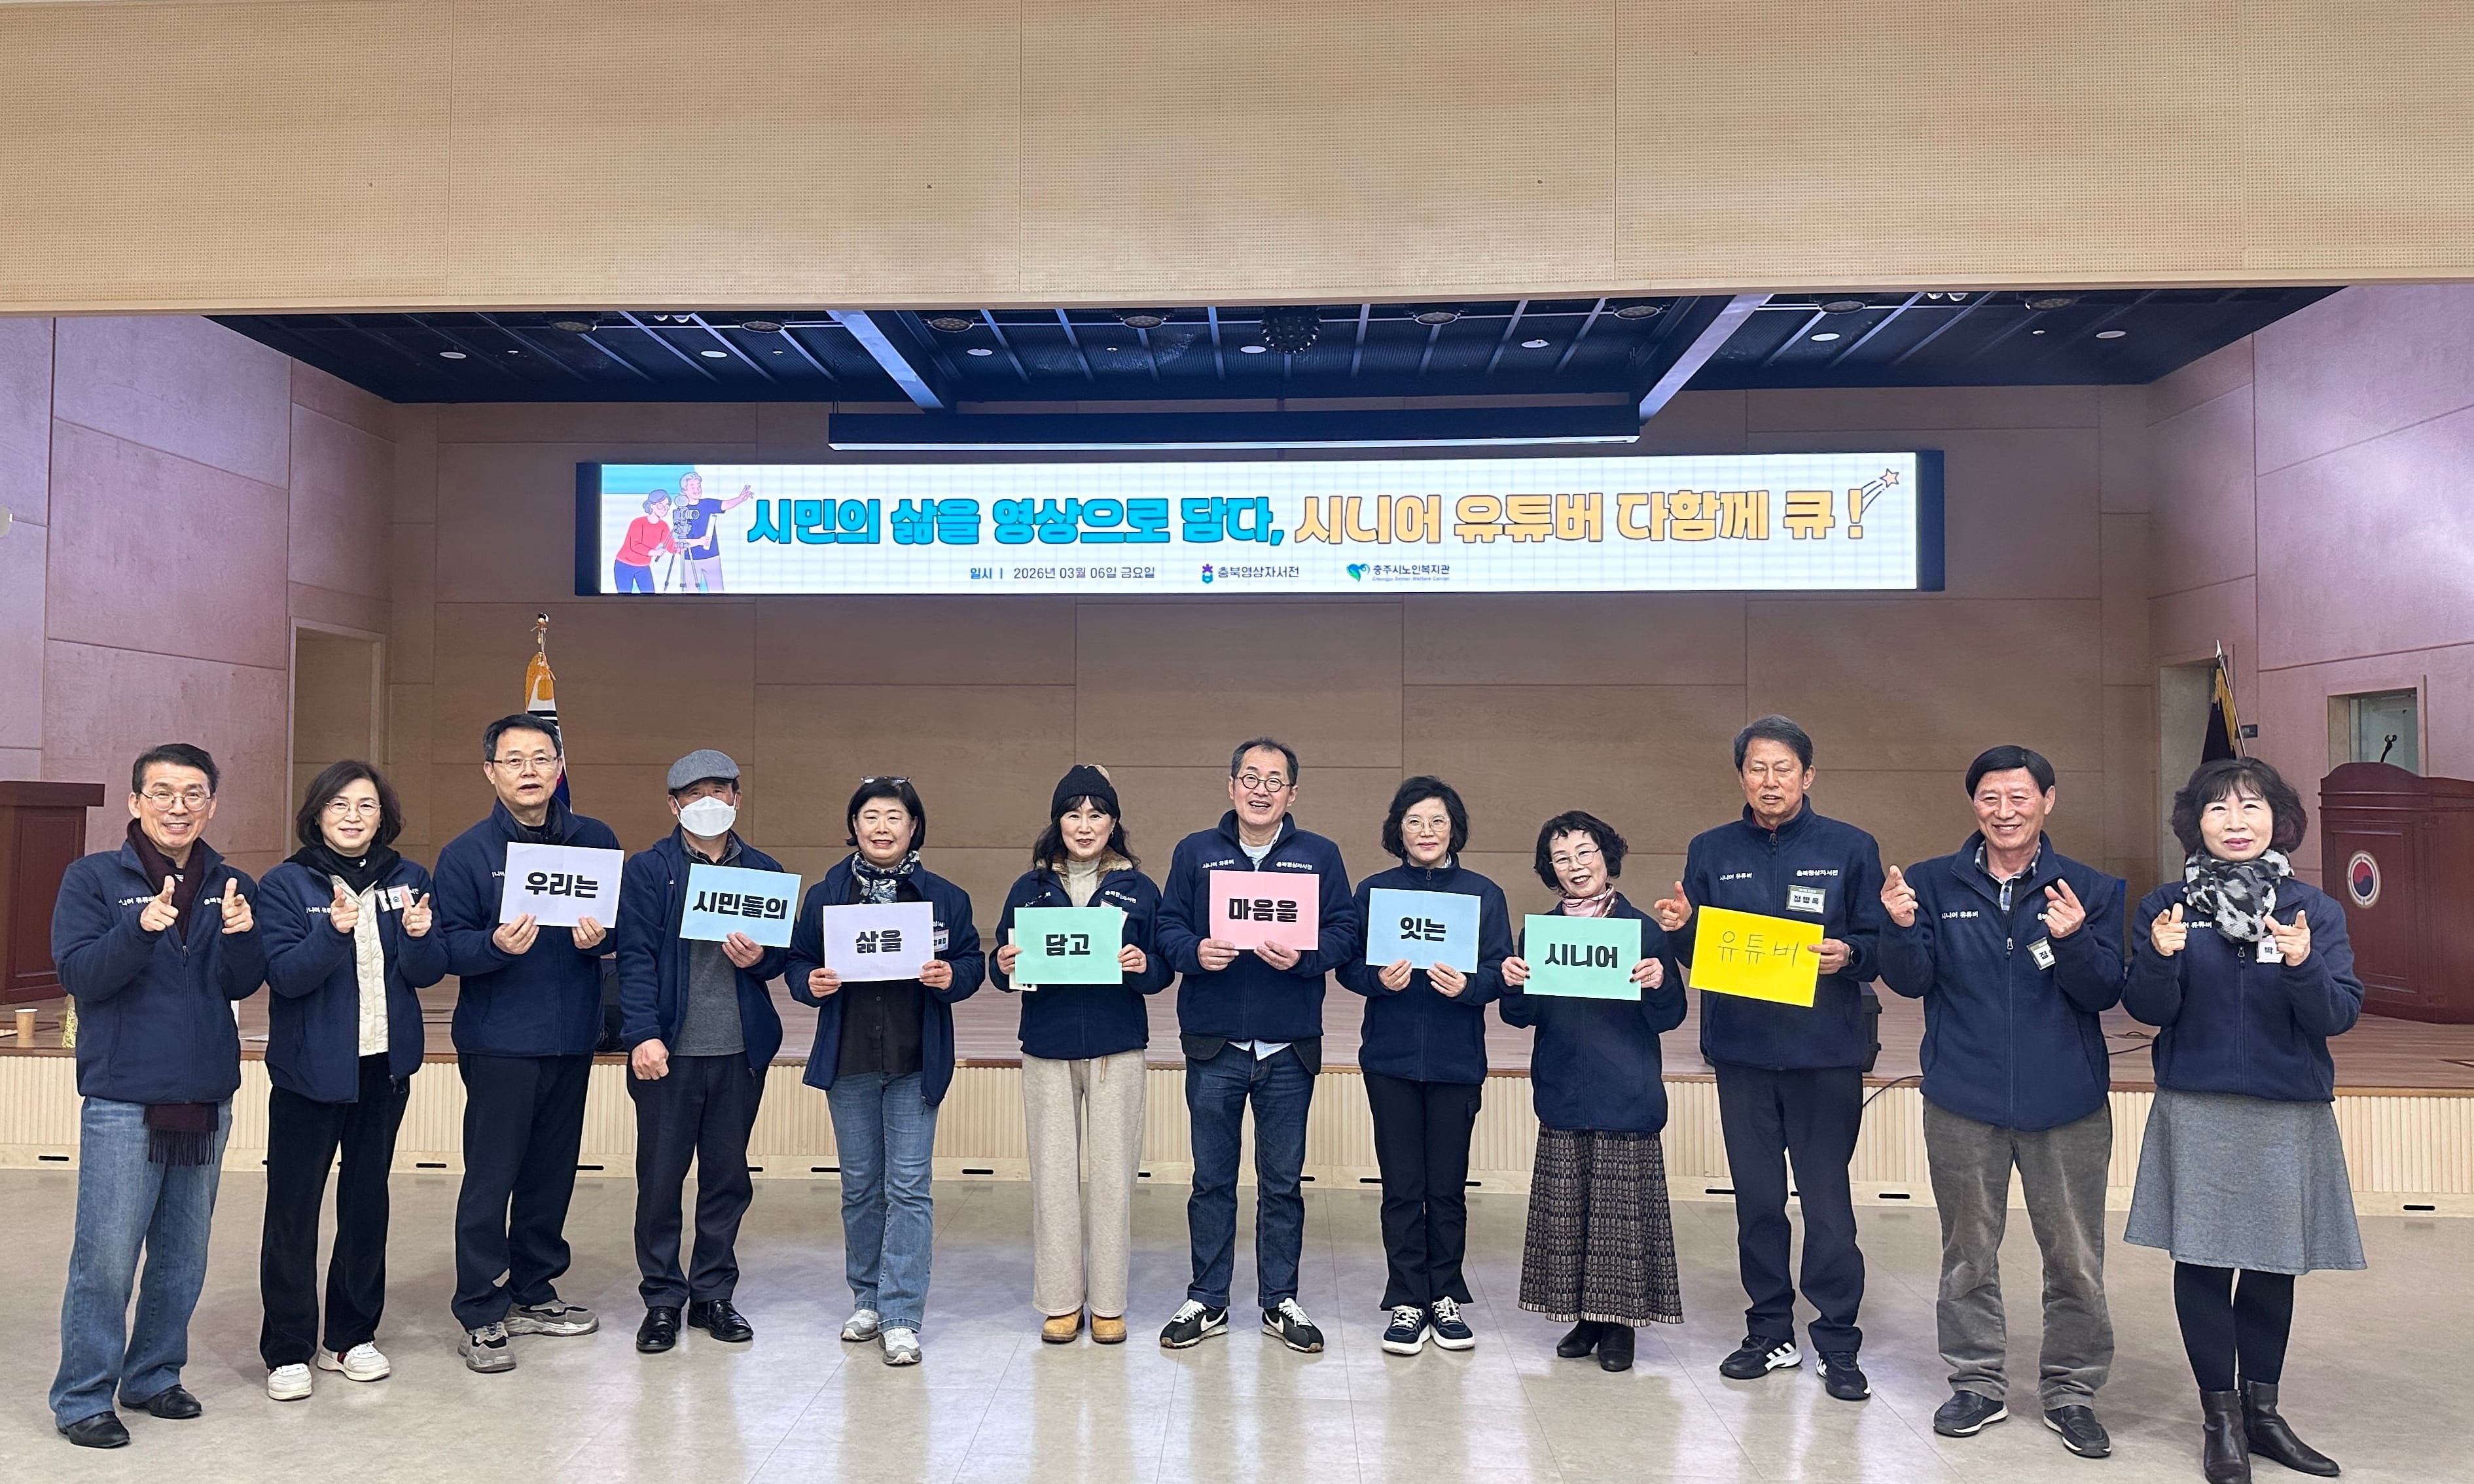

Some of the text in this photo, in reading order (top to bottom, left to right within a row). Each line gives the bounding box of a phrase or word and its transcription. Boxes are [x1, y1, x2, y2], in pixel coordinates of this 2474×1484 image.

[747, 488, 1864, 546] 시민의 삶을 영상으로 담다, 시니어 유튜버 다함께 큐 !
[970, 567, 992, 580] 일시
[1014, 567, 1056, 579] 2026년
[1059, 567, 1086, 579] 03월
[1090, 567, 1117, 578] 06일
[1120, 567, 1155, 578] 금요일
[1217, 565, 1300, 578] 충북영상자서전
[1372, 565, 1450, 576] 충주시노인복지관
[525, 871, 598, 899] 우리는
[692, 891, 788, 920] 시민들의
[1228, 898, 1298, 923] 마음을
[855, 930, 903, 954] 삶을
[1400, 917, 1446, 942] 잇는
[1046, 934, 1090, 956] 담고
[1545, 943, 1619, 969] 시니어
[1717, 930, 1800, 967] 유튜버
